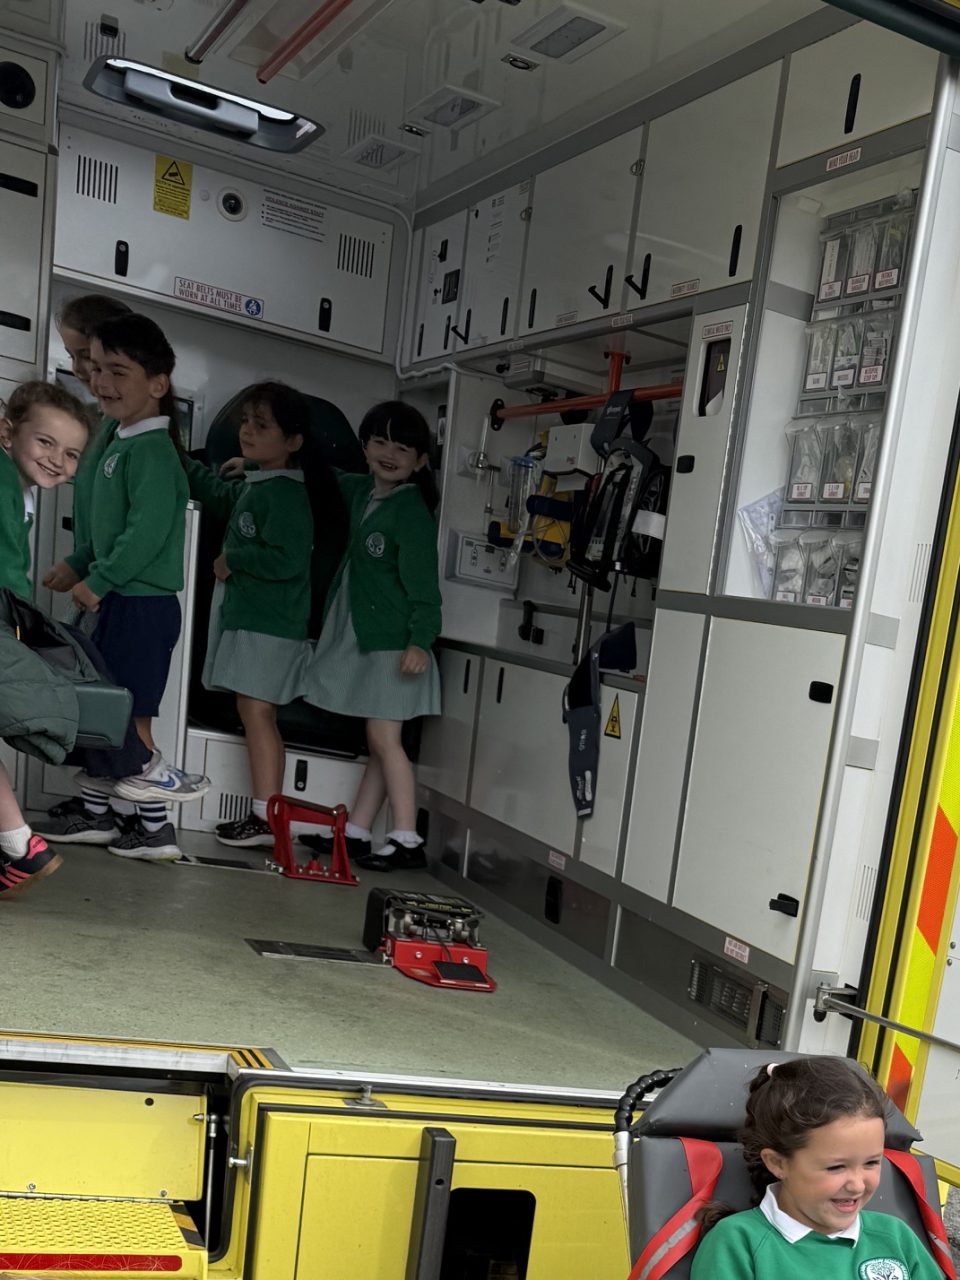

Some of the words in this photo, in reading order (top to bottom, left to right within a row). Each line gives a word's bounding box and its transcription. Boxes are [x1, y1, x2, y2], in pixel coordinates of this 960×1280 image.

[179, 279, 194, 291] SEAT
[196, 284, 214, 297] BELTS
[216, 290, 233, 301] MUST
[235, 294, 242, 304] BE
[179, 288, 199, 300] WORN
[200, 294, 208, 303] AT
[209, 297, 221, 307] ALL
[224, 300, 242, 312] TIMES
